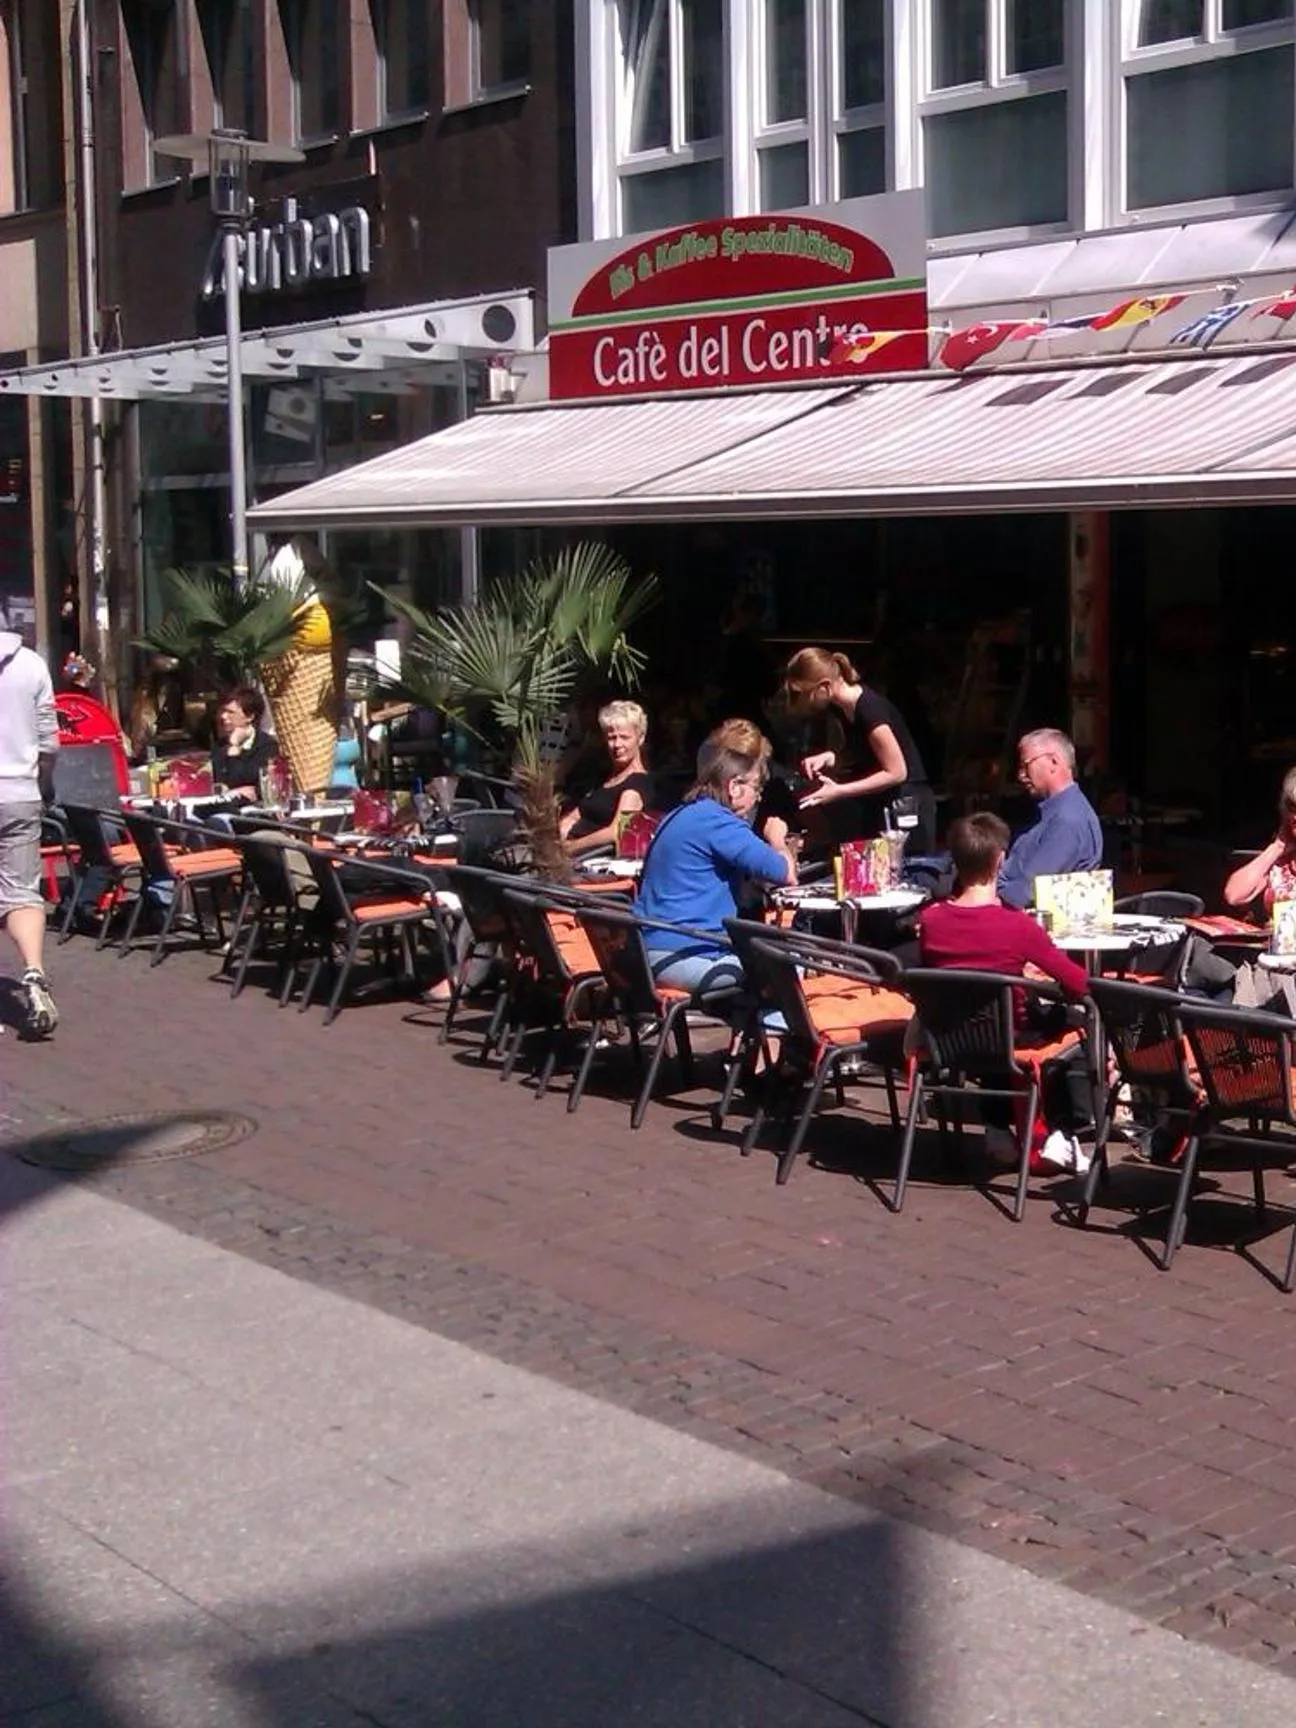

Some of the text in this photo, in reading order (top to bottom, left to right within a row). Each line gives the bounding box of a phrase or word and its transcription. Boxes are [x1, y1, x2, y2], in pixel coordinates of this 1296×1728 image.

[637, 251, 655, 281] &
[655, 231, 718, 273] Kaffee
[679, 325, 730, 378] del
